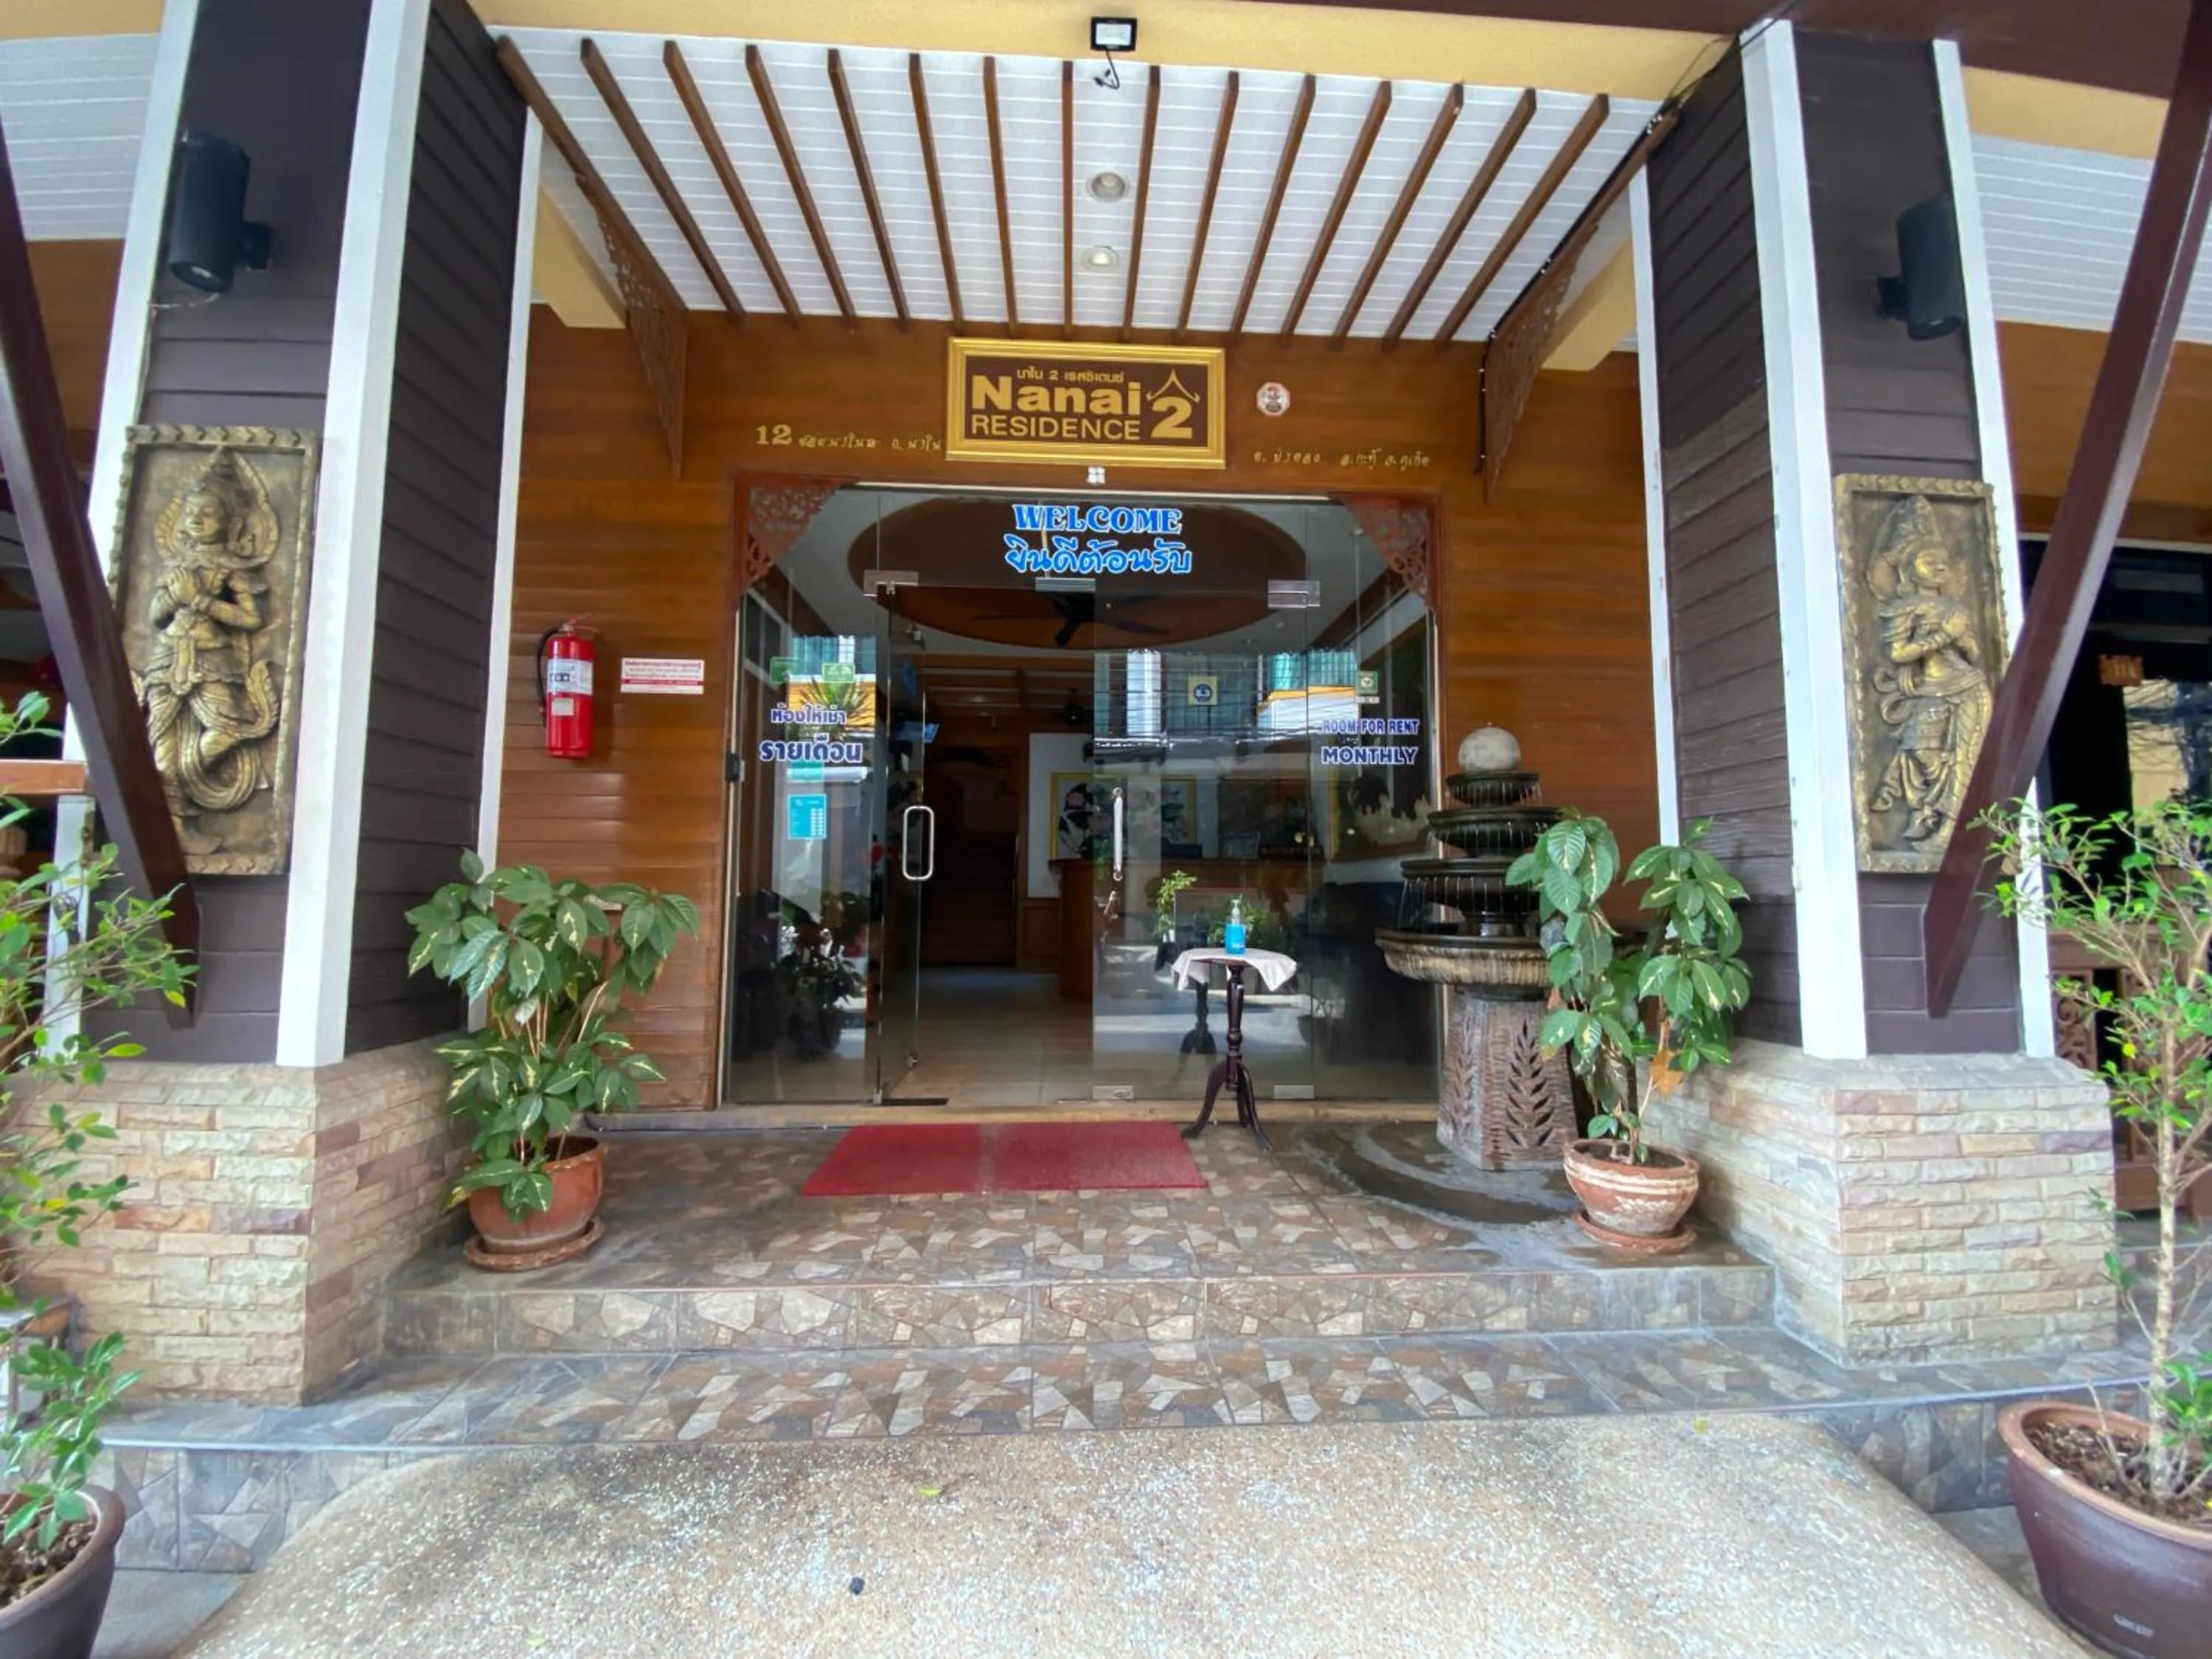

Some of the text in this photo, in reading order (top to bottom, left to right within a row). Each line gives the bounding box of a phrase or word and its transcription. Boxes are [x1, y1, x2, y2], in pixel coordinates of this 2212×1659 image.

[1049, 370, 1059, 380] 2
[972, 375, 1193, 439] Nanai 2
[756, 424, 792, 445] 12
[971, 414, 1141, 440] RESIDENCE
[1012, 504, 1183, 535] WELCOME
[1004, 533, 1192, 574] ยินดีต้อนรับ
[1321, 718, 1420, 735] ROOM FOR RENT
[759, 732, 864, 764] รายเดือน
[1321, 745, 1418, 765] MONTHLY
